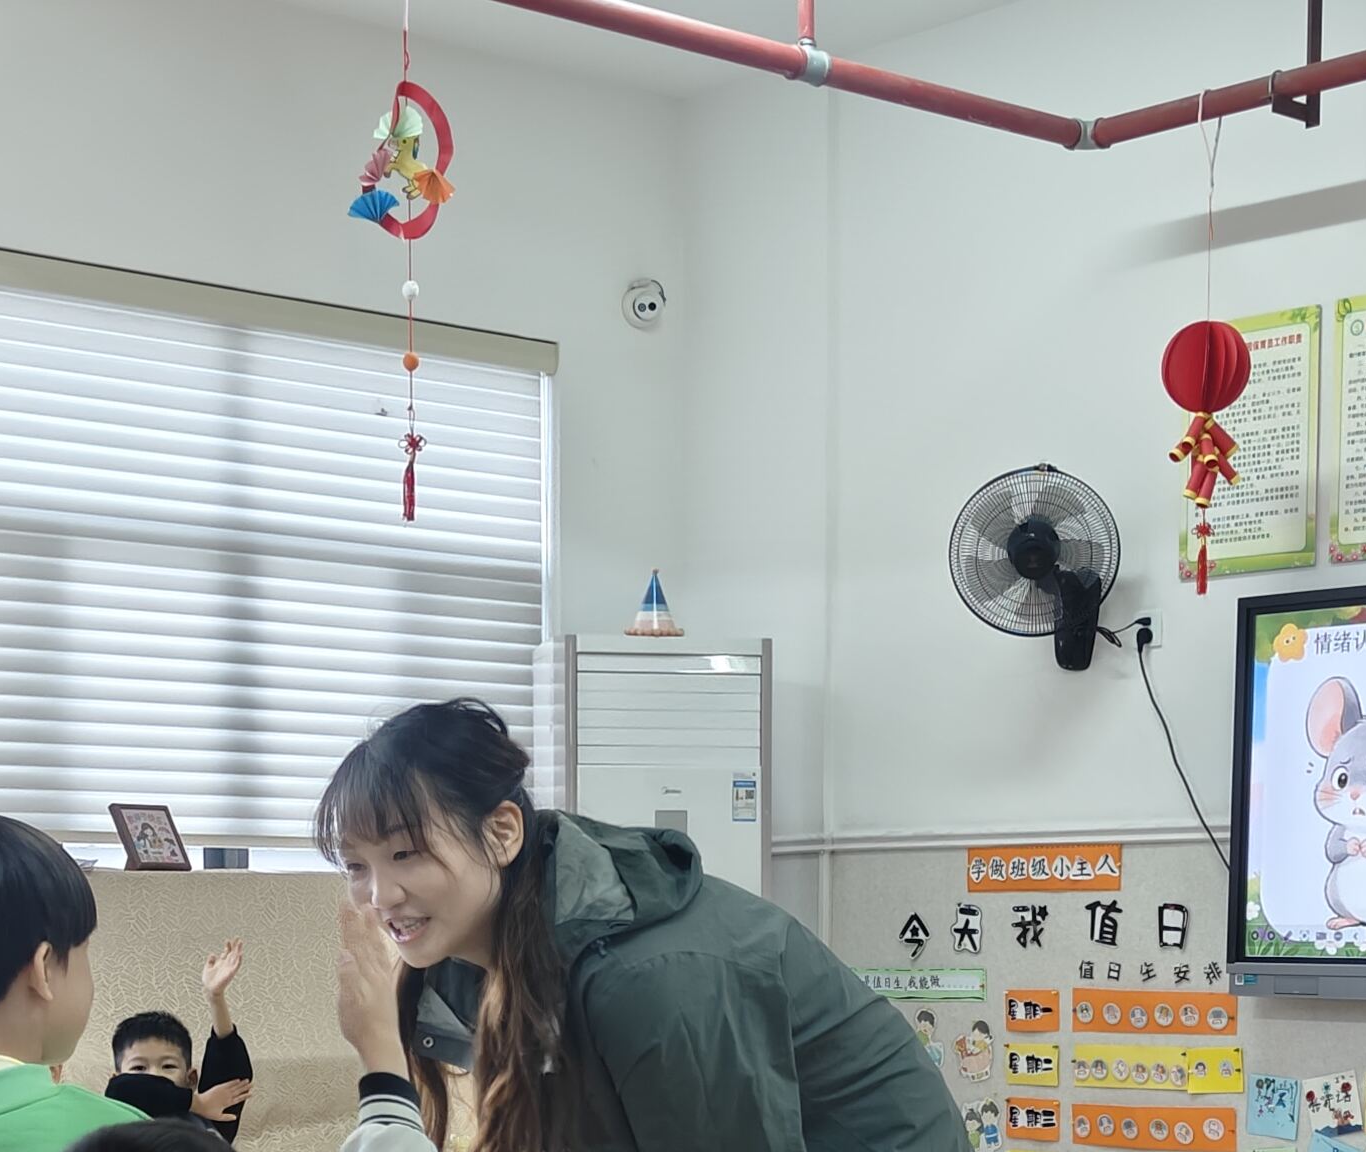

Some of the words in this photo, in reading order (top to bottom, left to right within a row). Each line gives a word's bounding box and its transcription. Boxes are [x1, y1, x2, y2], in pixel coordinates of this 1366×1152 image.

[970, 853, 1117, 881] 学做班级小主人
[899, 900, 1190, 958] 今天我值日
[1078, 960, 1223, 985] 值日生安排
